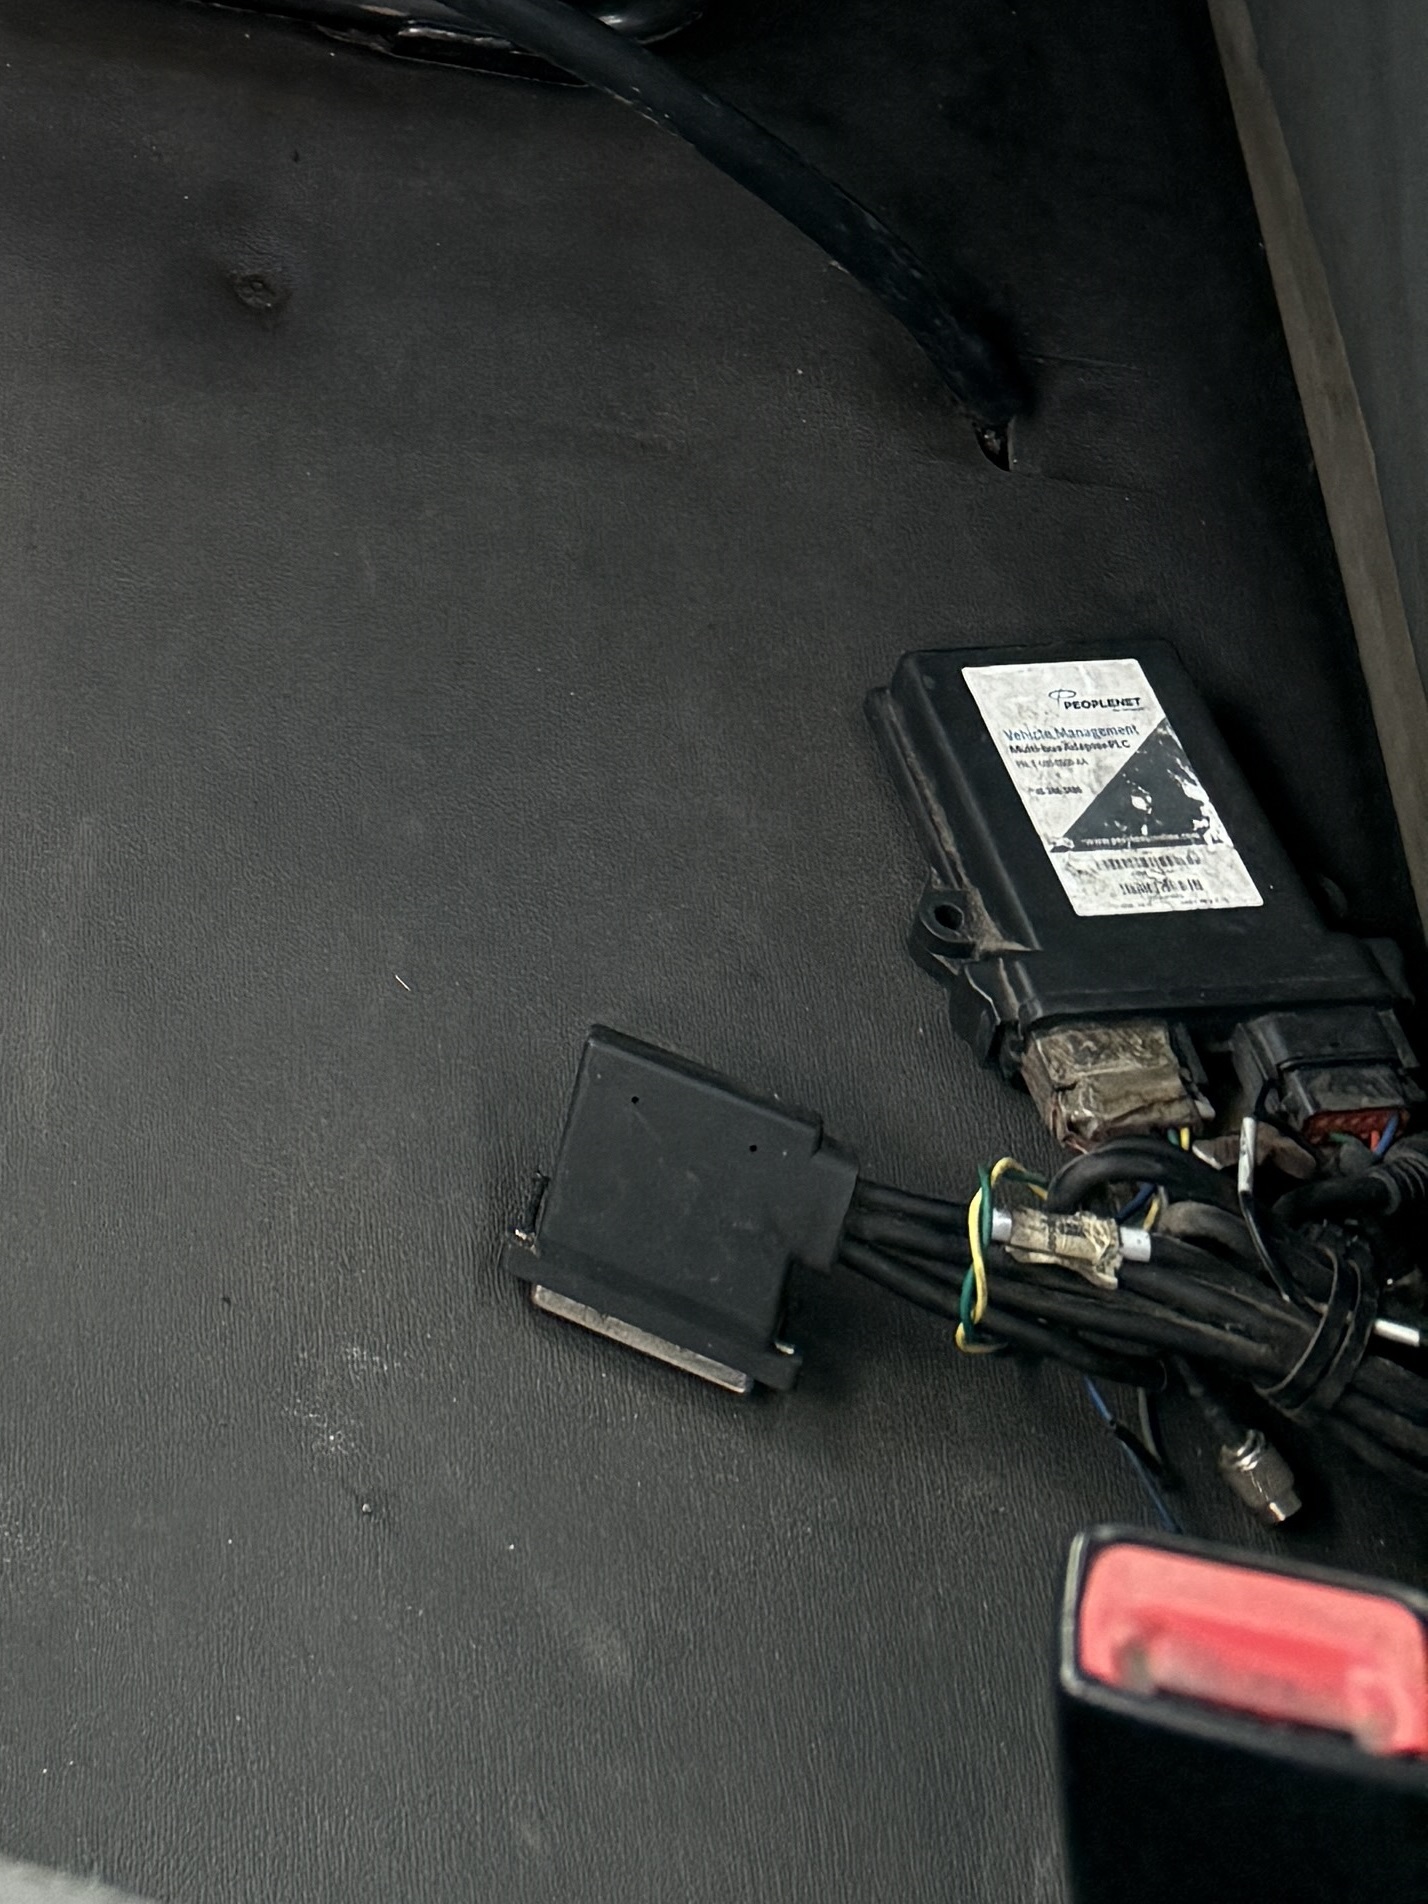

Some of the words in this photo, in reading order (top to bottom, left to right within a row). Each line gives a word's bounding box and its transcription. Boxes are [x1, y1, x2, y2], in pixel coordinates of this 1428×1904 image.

[1064, 697, 1140, 709] PEOPLENET
[1003, 729, 1055, 740] Vehicle
[1054, 724, 1139, 737] Management
